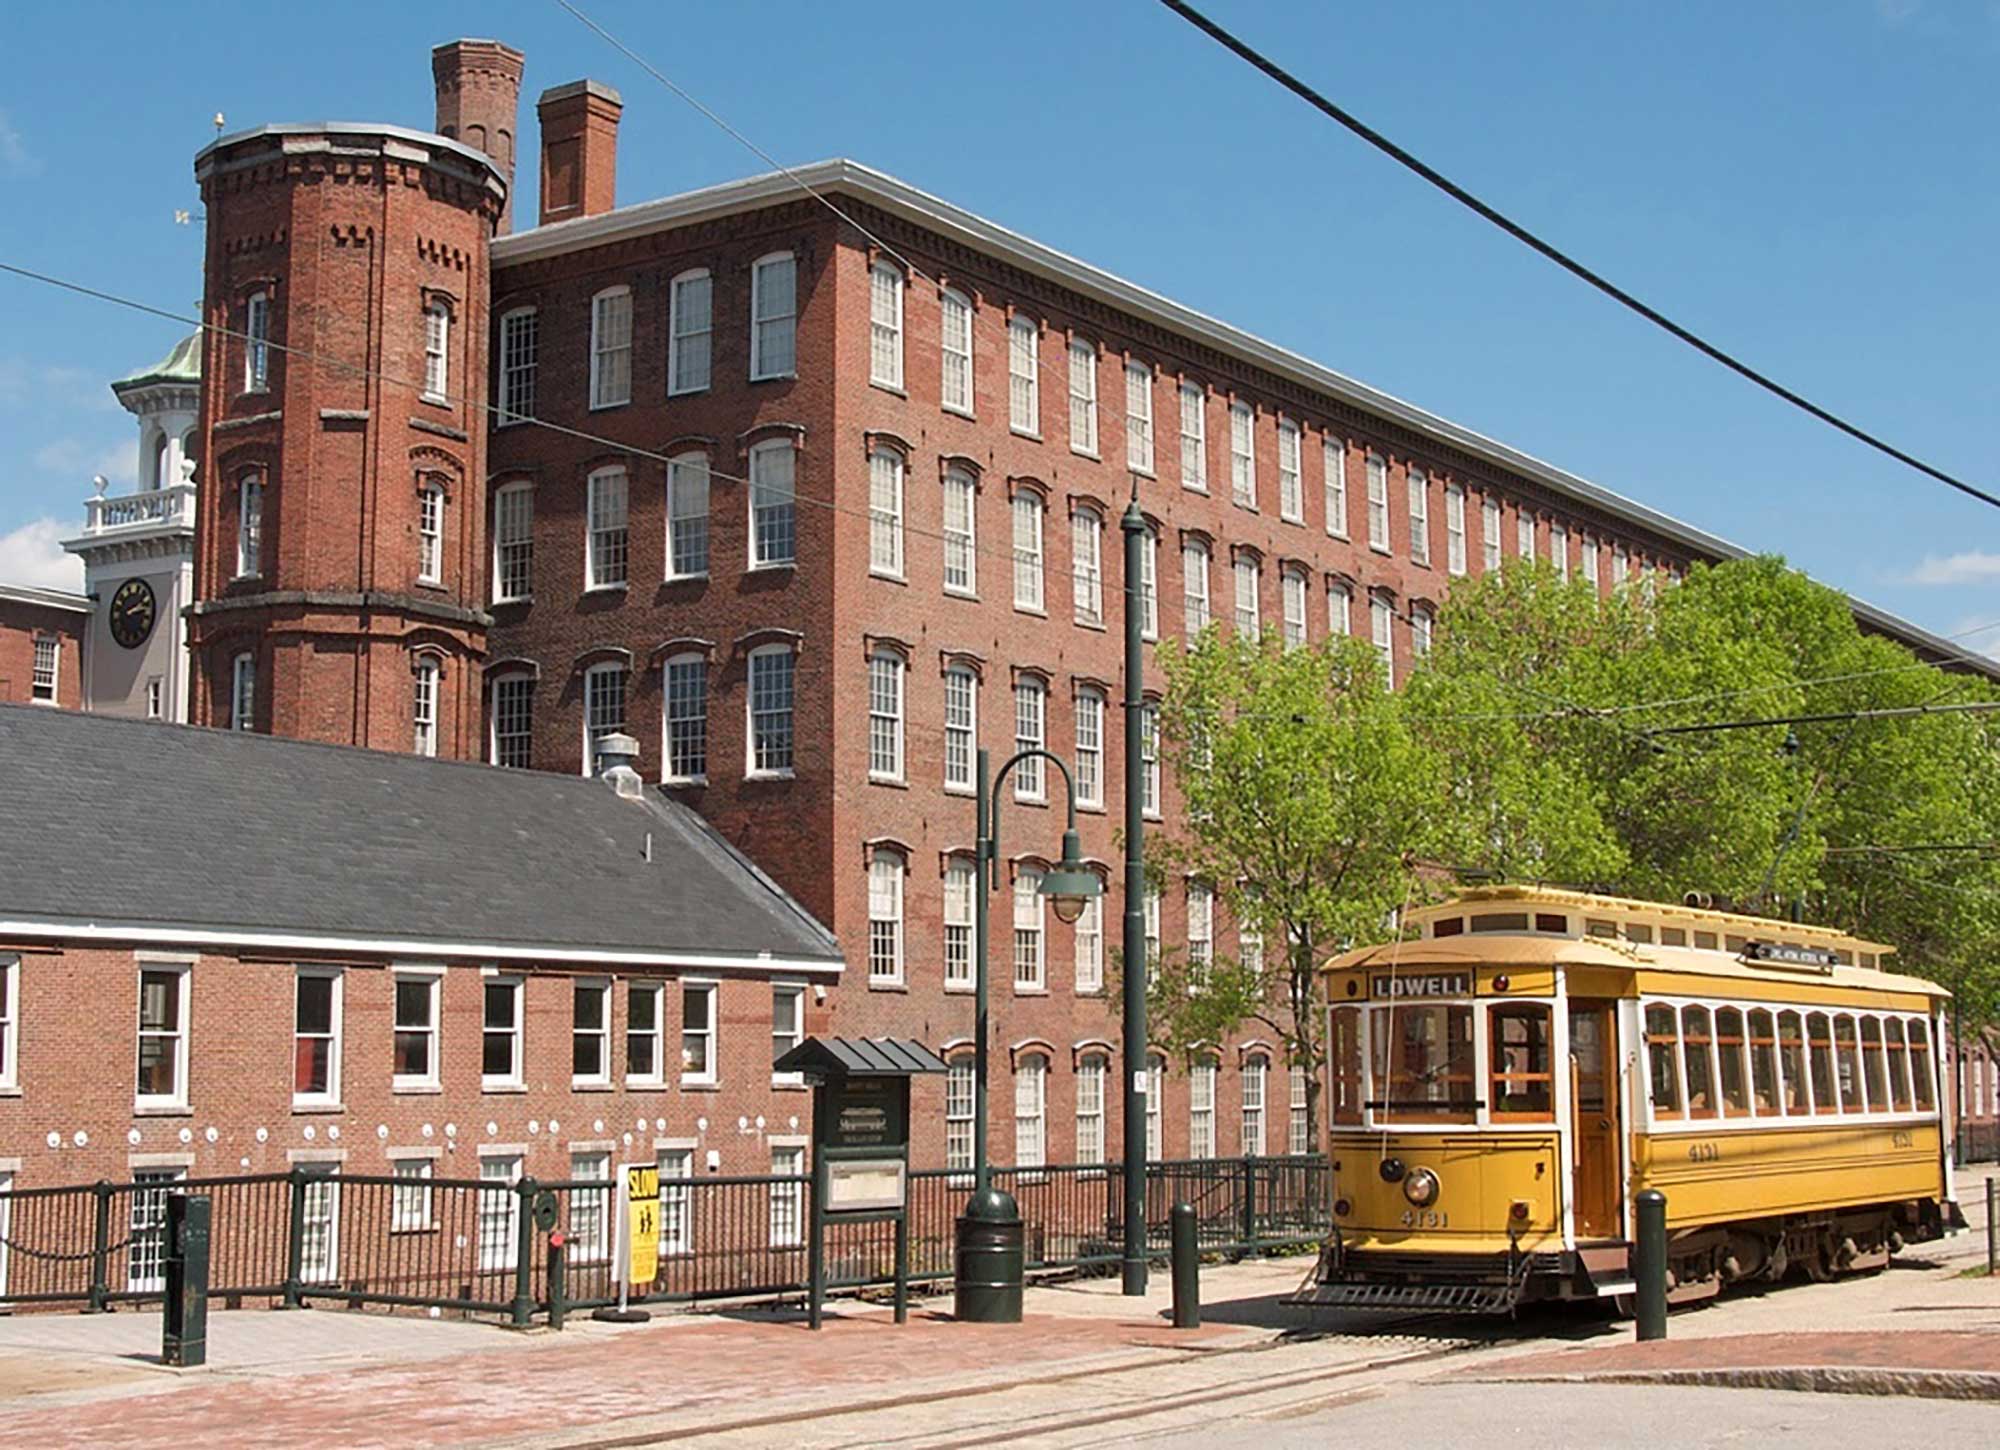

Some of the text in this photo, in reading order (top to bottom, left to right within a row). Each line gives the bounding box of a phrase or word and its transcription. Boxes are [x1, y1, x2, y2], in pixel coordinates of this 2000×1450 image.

[1376, 977, 1467, 996] LOWELL
[1689, 1143, 1719, 1162] 4131
[629, 1168, 658, 1198] SLOW
[1400, 1209, 1448, 1228] 4131
